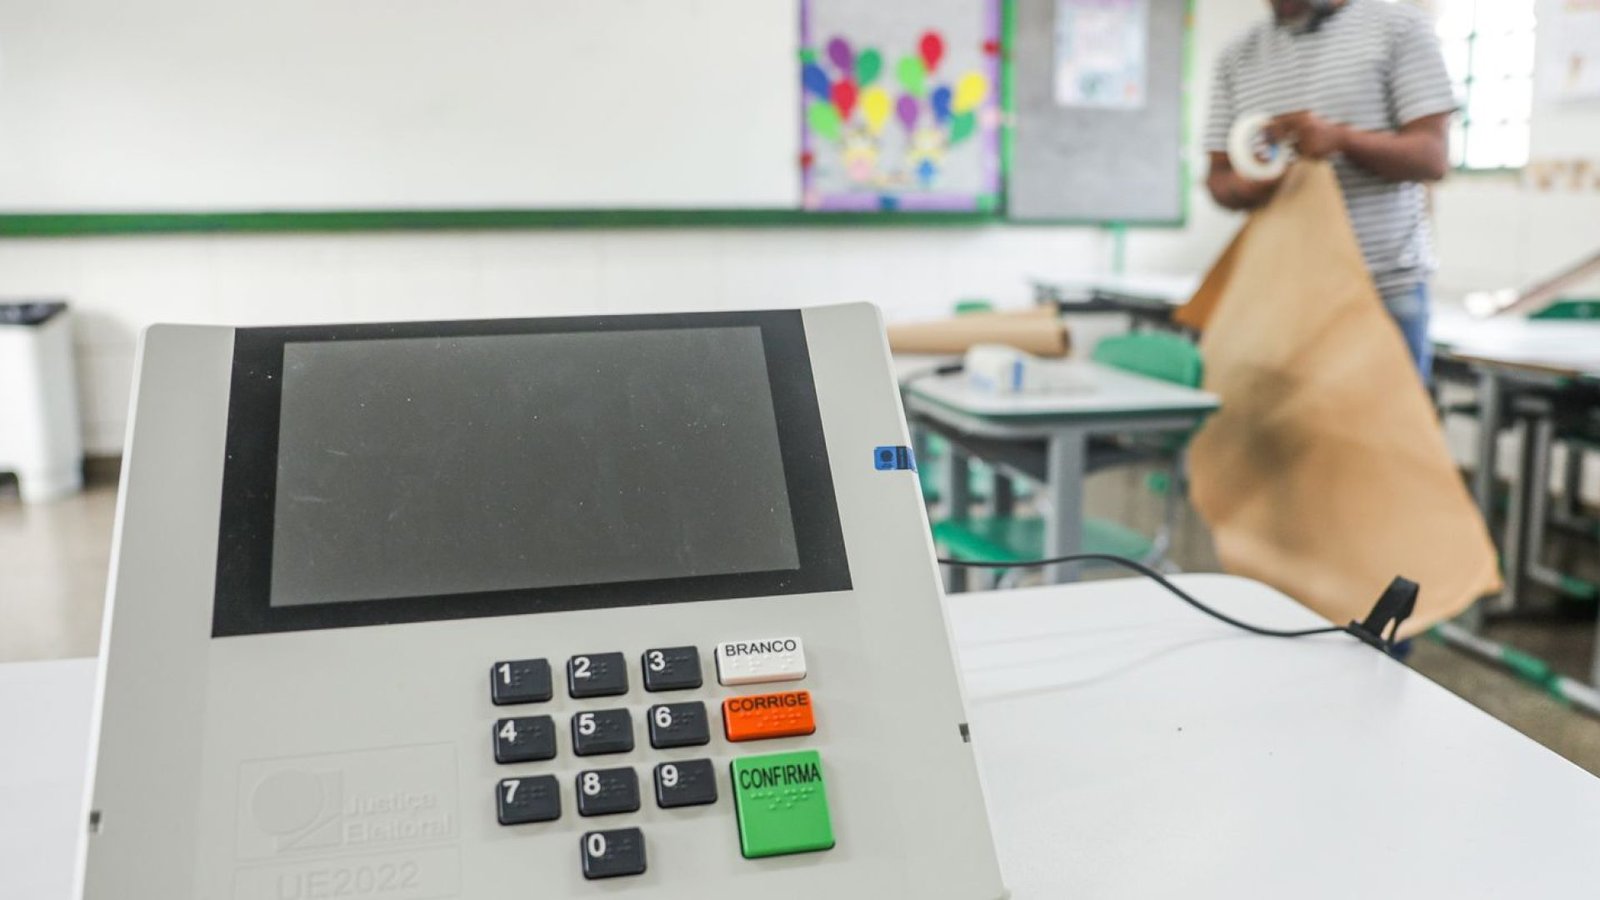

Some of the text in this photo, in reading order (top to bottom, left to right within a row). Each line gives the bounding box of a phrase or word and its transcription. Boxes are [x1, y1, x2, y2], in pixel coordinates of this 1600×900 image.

[724, 639, 797, 657] BRANCO
[574, 656, 591, 679] 2
[649, 651, 666, 671] 3
[499, 663, 512, 684] 1
[728, 692, 808, 713] CORRIGE
[579, 713, 596, 735] 5
[654, 706, 671, 728] 6
[499, 720, 517, 742] 4
[582, 772, 600, 795] 8
[660, 764, 678, 787] 9
[739, 762, 822, 790] CONFIRMA
[502, 780, 520, 803] 7
[588, 833, 606, 857] 0
[277, 861, 419, 899] UE2022
